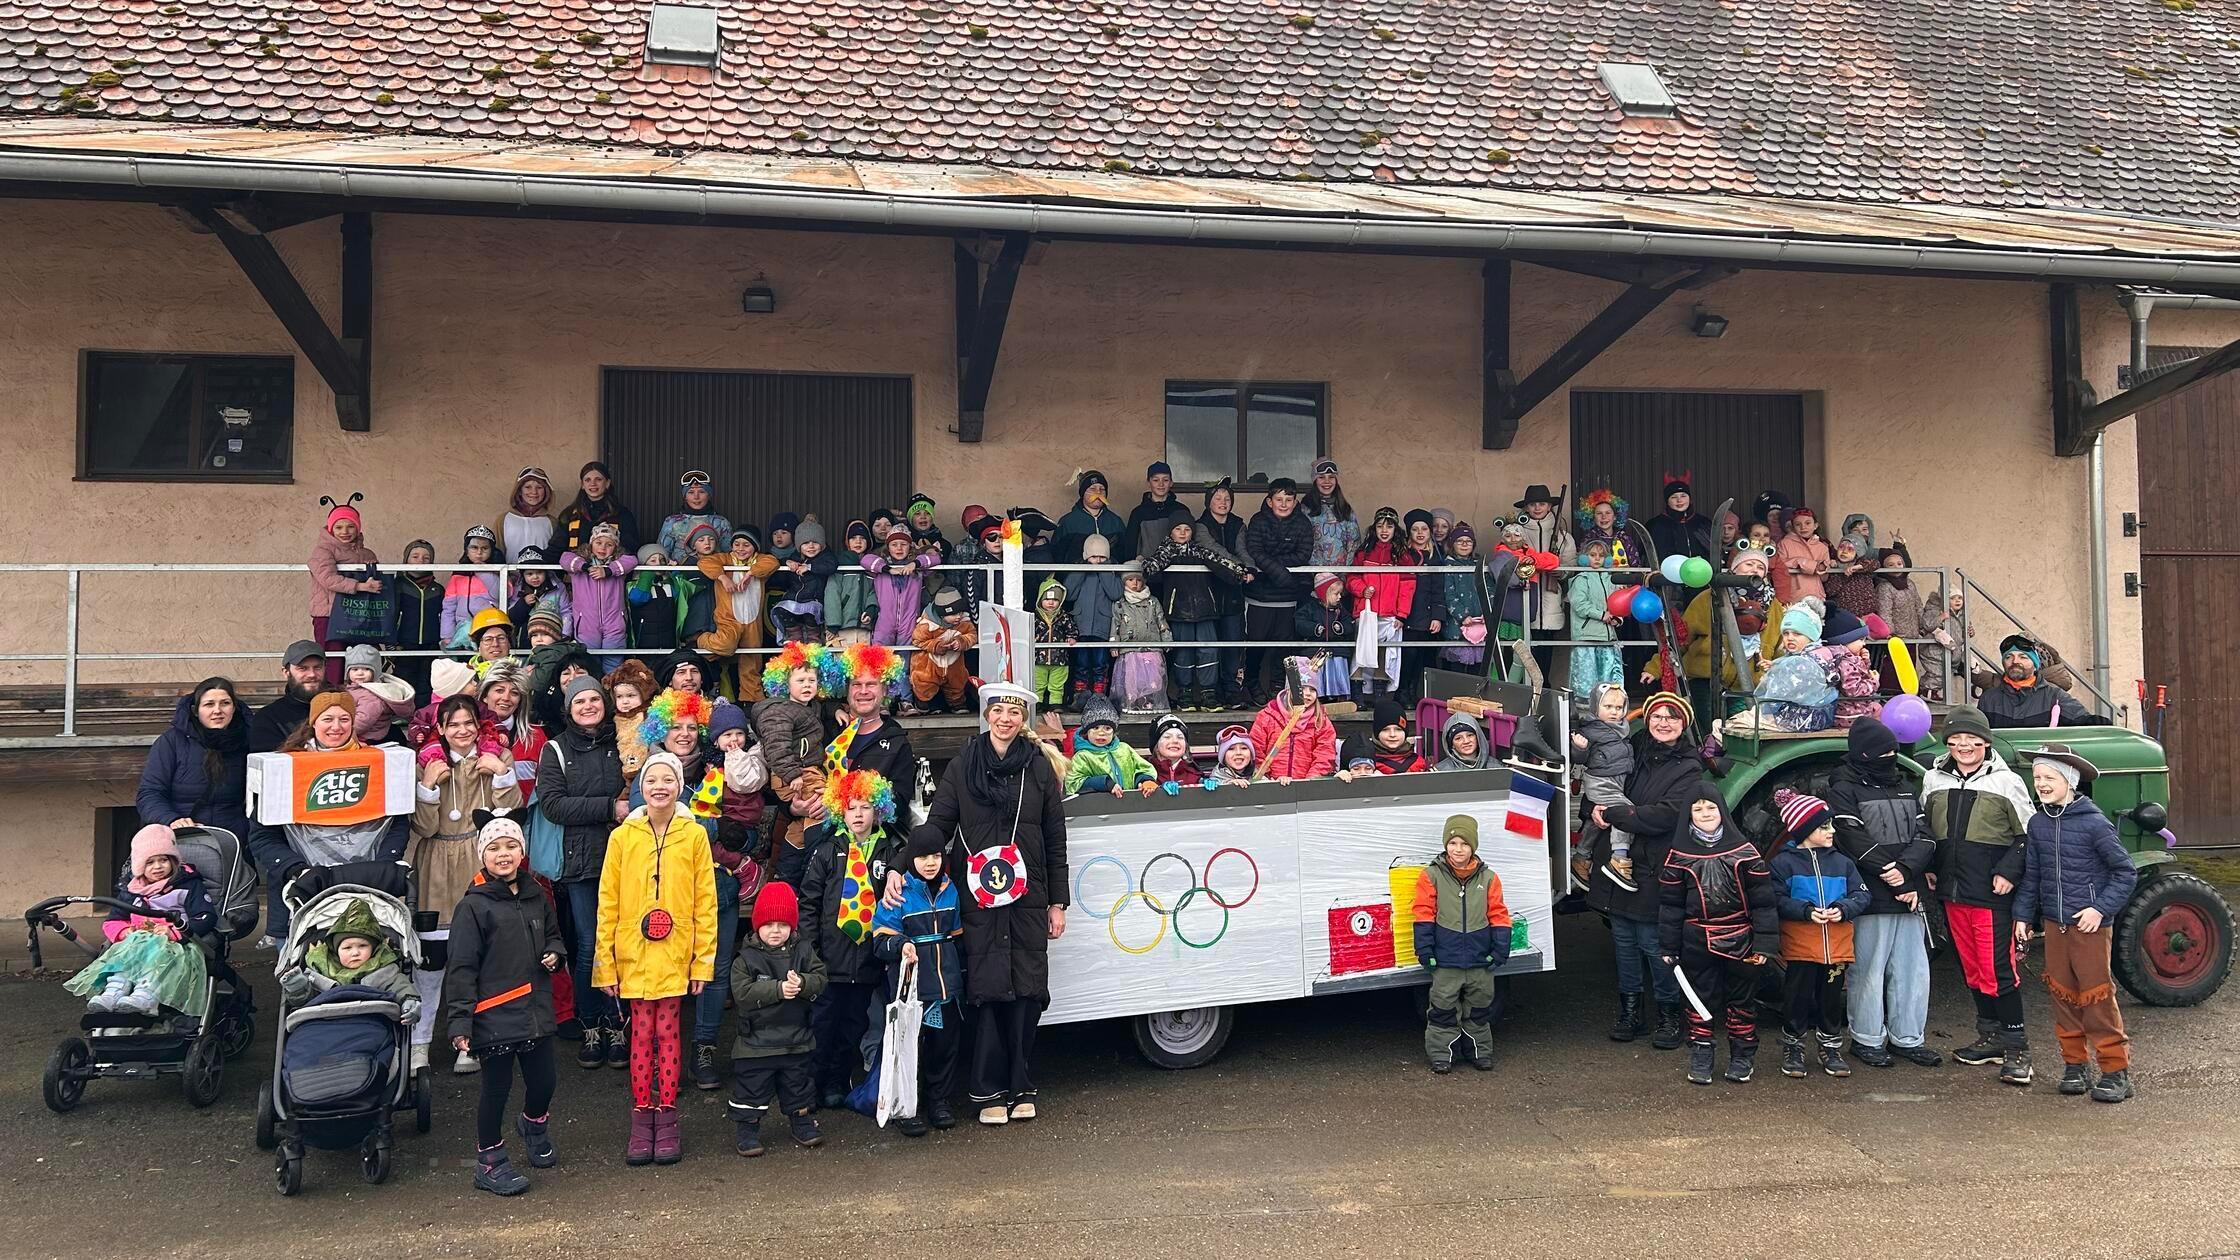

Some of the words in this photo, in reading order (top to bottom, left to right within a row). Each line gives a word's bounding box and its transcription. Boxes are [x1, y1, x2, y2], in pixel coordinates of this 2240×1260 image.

[326, 770, 361, 790] tic
[315, 787, 360, 805] tac
[1357, 917, 1367, 930] 2
